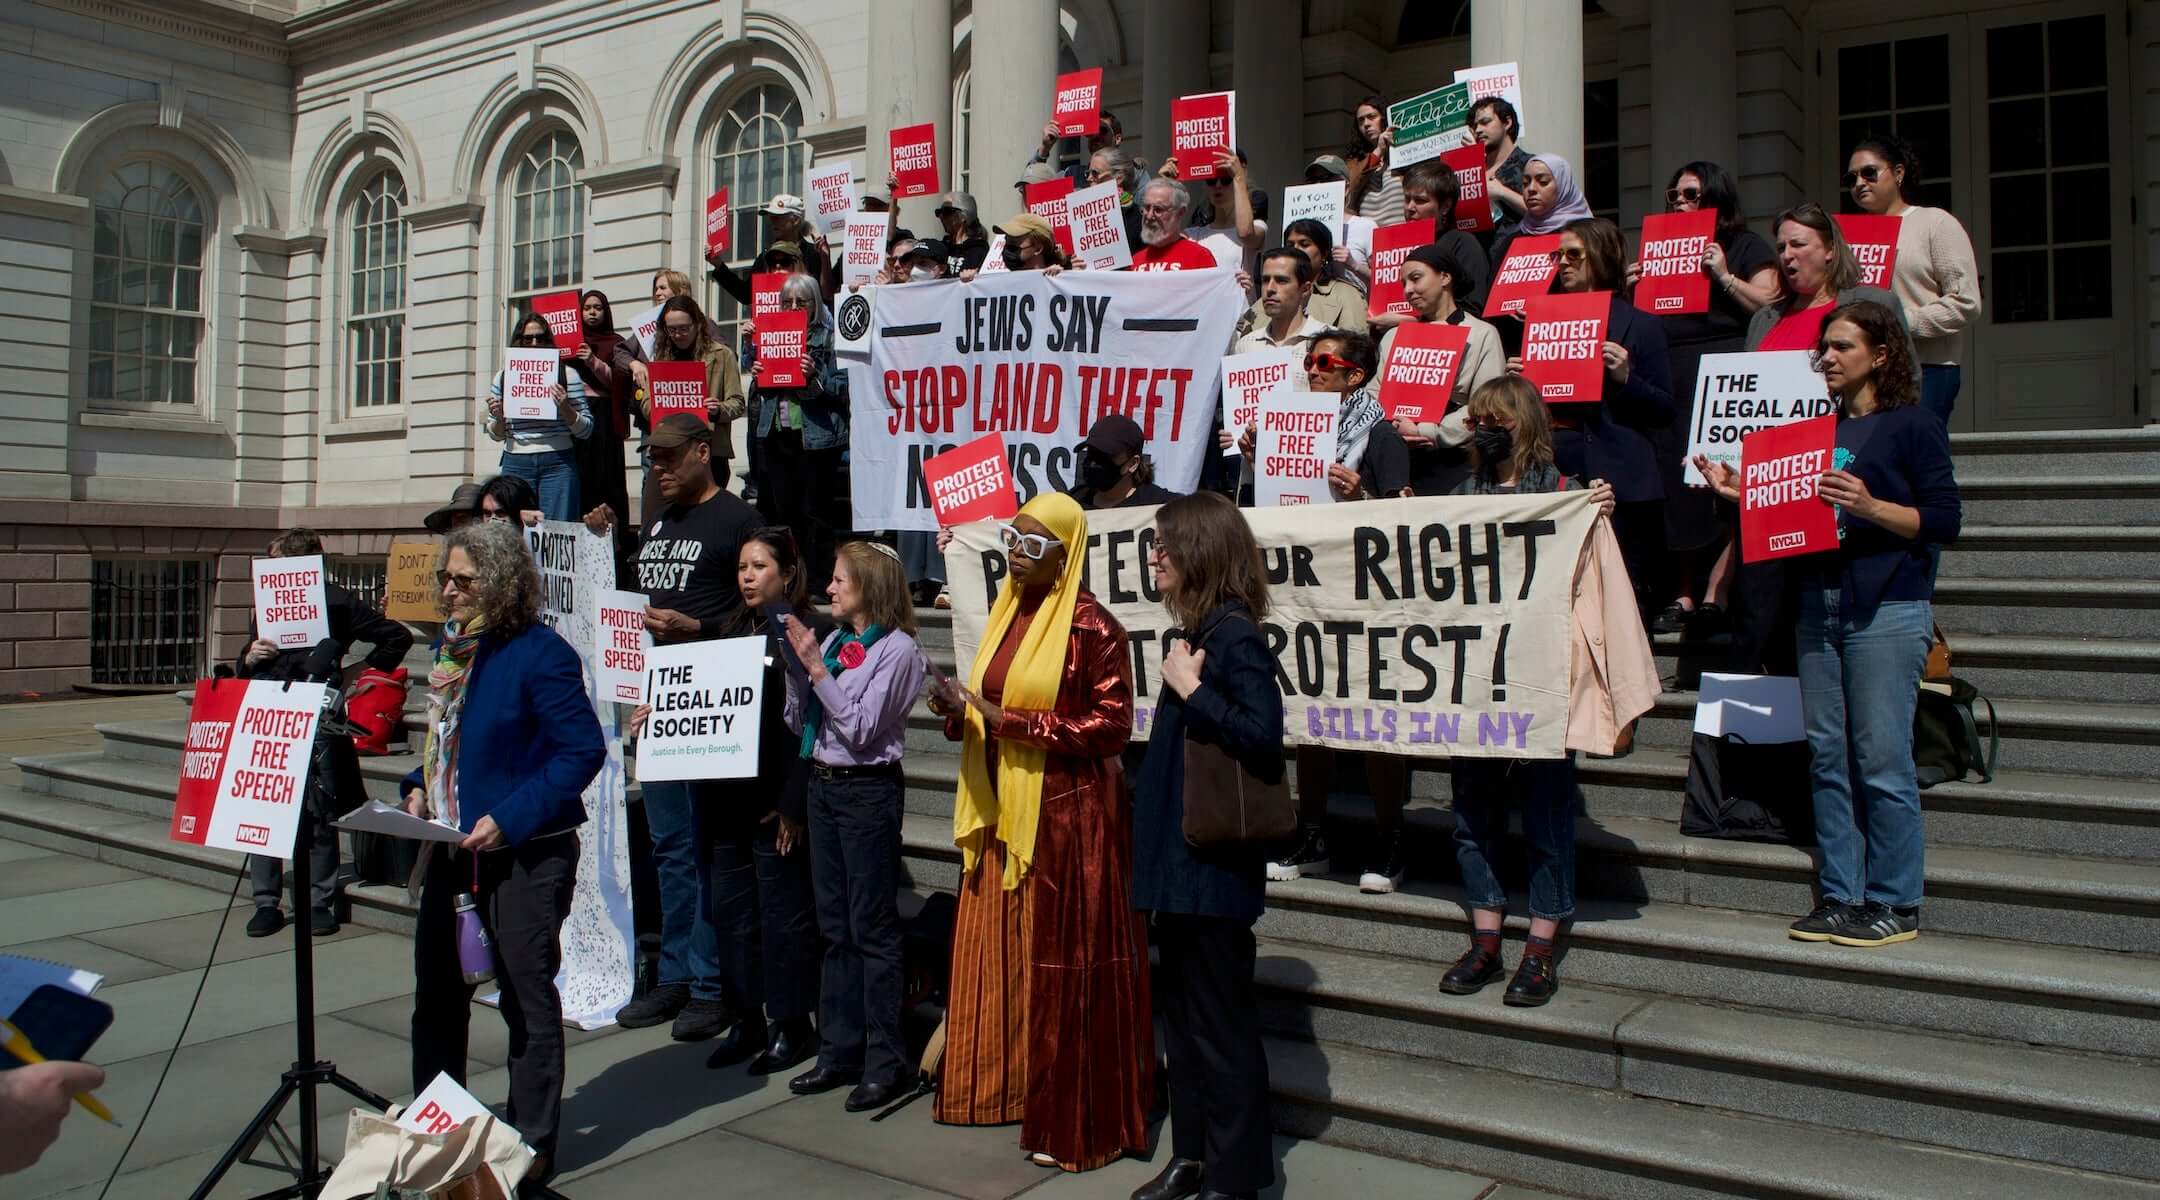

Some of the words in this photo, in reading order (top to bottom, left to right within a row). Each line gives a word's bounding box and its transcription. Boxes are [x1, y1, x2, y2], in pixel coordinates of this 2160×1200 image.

[1058, 85, 1097, 100] PROTECT
[1469, 75, 1515, 92] ROTECT
[1056, 98, 1096, 114] PROTEST
[1175, 117, 1224, 135] PROTECT
[893, 142, 932, 159] PROTECT
[1176, 133, 1225, 150] PROTEST
[894, 156, 932, 172] PROTEST
[812, 172, 850, 190] PROTECT
[822, 187, 843, 201] FREE
[1459, 182, 1483, 201] TEST
[818, 200, 850, 215] SPEECH
[1072, 194, 1116, 221] PROTECT
[848, 224, 886, 237] PROTECT
[1085, 215, 1109, 234] FREE
[854, 238, 876, 251] FREE
[1079, 228, 1120, 251] SPEECH
[1644, 236, 1708, 257] PROTECT
[848, 252, 879, 265] SPEECH
[1641, 255, 1704, 278] PROTEST
[1497, 266, 1554, 285] PROTEST
[755, 291, 782, 305] PROT
[1655, 297, 1684, 310] NYCLU
[544, 308, 577, 324] ROTECT
[956, 294, 1034, 355] JEWS
[1047, 294, 1112, 354] SAY
[760, 331, 803, 345] PROTECT
[1528, 319, 1602, 341] PROTECT
[760, 345, 802, 359] PROTEST
[1391, 347, 1457, 368] PROTECT
[1526, 339, 1599, 362] PROTEST
[509, 359, 555, 372] PROTECT
[519, 372, 544, 386] FREE
[1228, 364, 1289, 389] PROTECT
[1387, 365, 1451, 387] PROTEST
[1715, 374, 1758, 393] THE
[511, 385, 551, 399] SPEECH
[653, 381, 703, 395] PROTECT
[1243, 384, 1275, 405] FR
[1542, 384, 1574, 396] NYCLU
[654, 395, 704, 409] PROTEST
[884, 364, 967, 436] STOP
[973, 362, 1063, 434] LAND
[1077, 366, 1194, 441] THEFT
[1394, 405, 1422, 417] NYCLU
[1711, 399, 1784, 418] LEGAL
[1789, 399, 1834, 418] AID
[1265, 411, 1335, 433] PROTECT
[1278, 434, 1316, 455] FREE
[932, 454, 1002, 497] PROTECT
[1266, 456, 1324, 479] SPEECH
[1746, 449, 1827, 486] PROTECT
[937, 471, 1006, 514] PROTEST
[1745, 473, 1823, 511] PROTEST
[668, 539, 703, 561] AND
[1769, 531, 1806, 551] NYCLU
[1264, 544, 1321, 587] UR
[1353, 519, 1556, 605] RIGHT
[260, 570, 319, 590] PROTECT
[274, 588, 307, 606] FREE
[265, 604, 318, 623] SPEECH
[600, 607, 647, 630] PROTEC
[280, 633, 307, 644] NYCLU
[613, 630, 641, 651] FREE
[1262, 621, 1512, 705] ROTEST!
[658, 665, 693, 686] THE
[616, 684, 640, 700] NYCLU
[655, 689, 714, 712] LEGAL
[719, 686, 754, 707] AID
[240, 707, 314, 740] PROTECT
[653, 713, 735, 738] SOCIETY
[1306, 705, 1398, 743] BILLS
[1409, 711, 1461, 745] IN
[1478, 712, 1535, 749] NY
[187, 721, 232, 750] PROTECT
[250, 739, 291, 771] FREE
[686, 745, 707, 757] Every
[707, 741, 744, 755] Borough.
[181, 751, 223, 781] PROTEST
[230, 769, 295, 804] SPEECH
[180, 815, 196, 834] NYCLU
[236, 824, 270, 847] NYCLU
